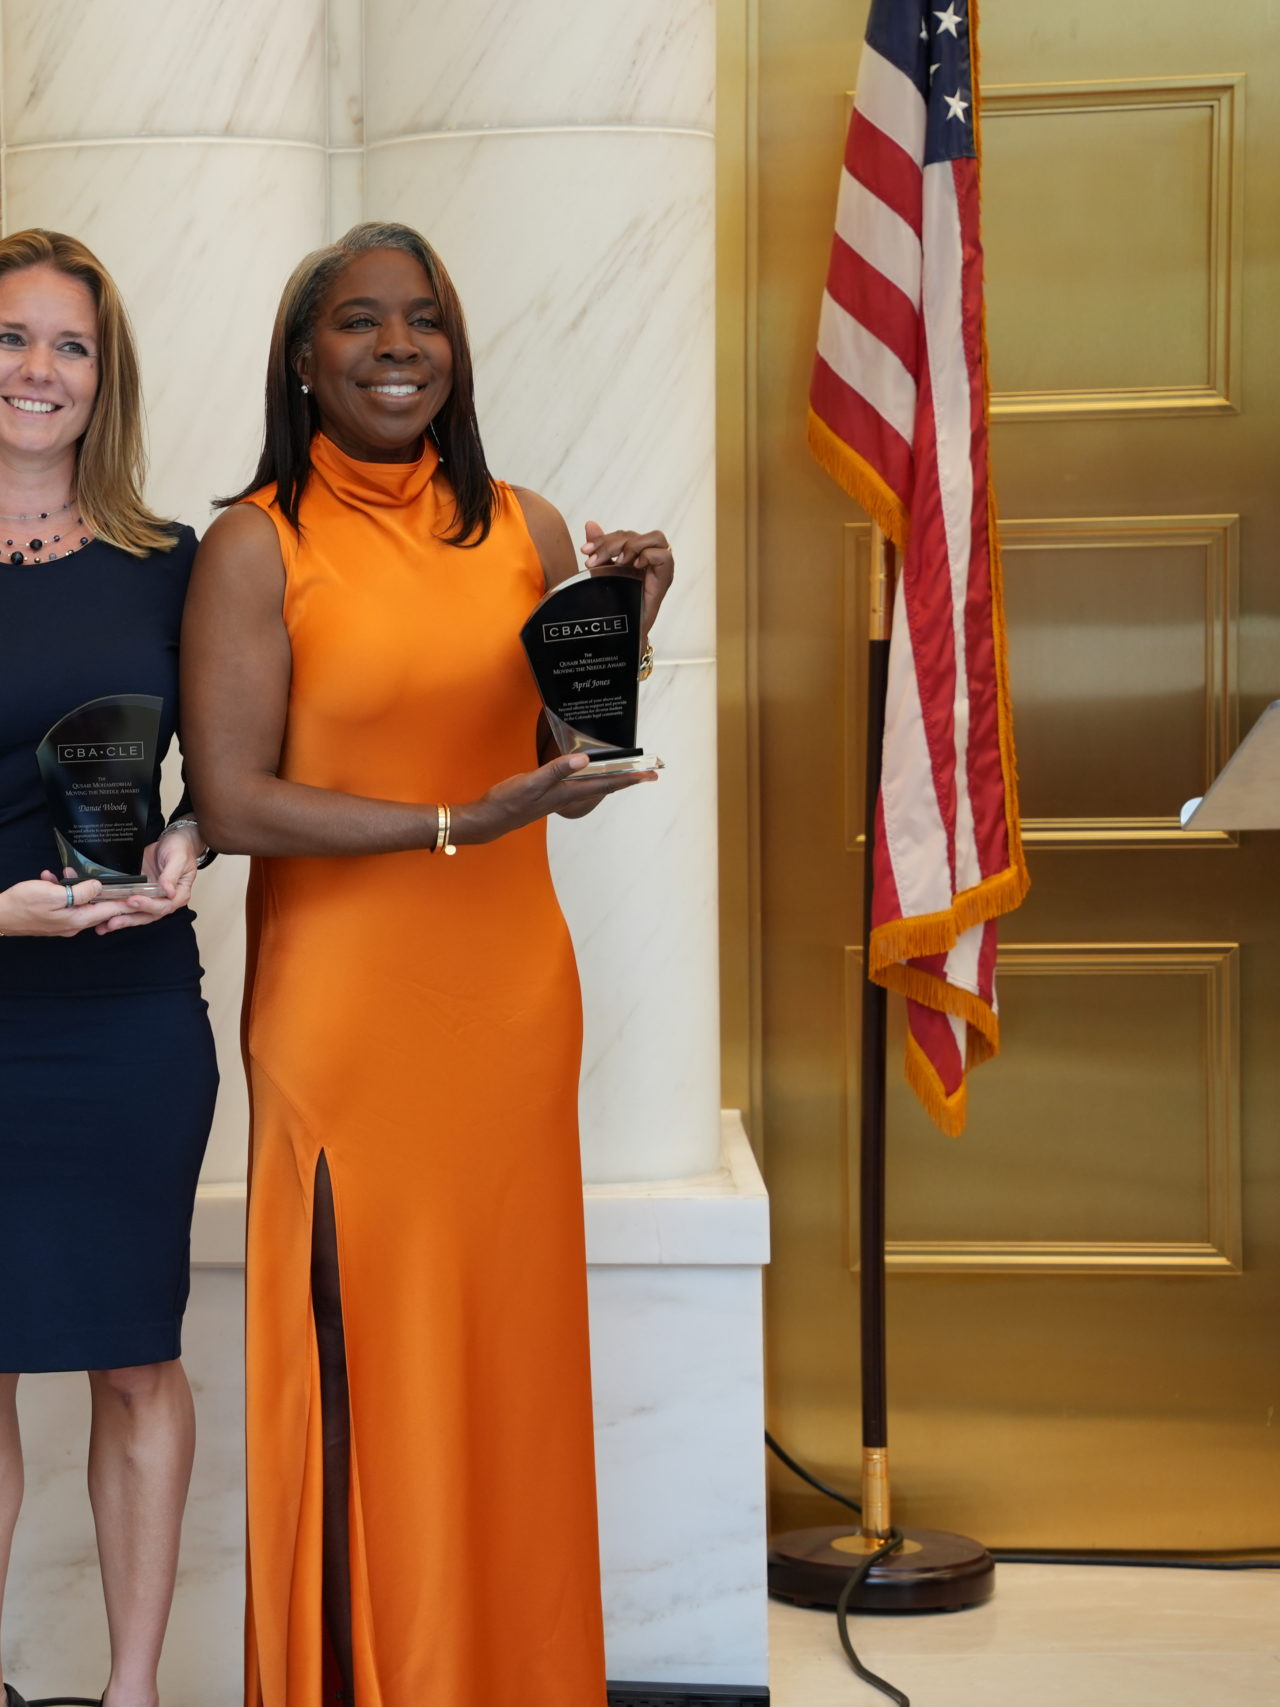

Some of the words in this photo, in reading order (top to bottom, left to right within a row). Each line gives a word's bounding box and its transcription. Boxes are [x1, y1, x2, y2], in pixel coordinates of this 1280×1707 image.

[572, 679, 592, 692] April
[591, 679, 611, 688] Jones
[102, 801, 128, 814] Woody
